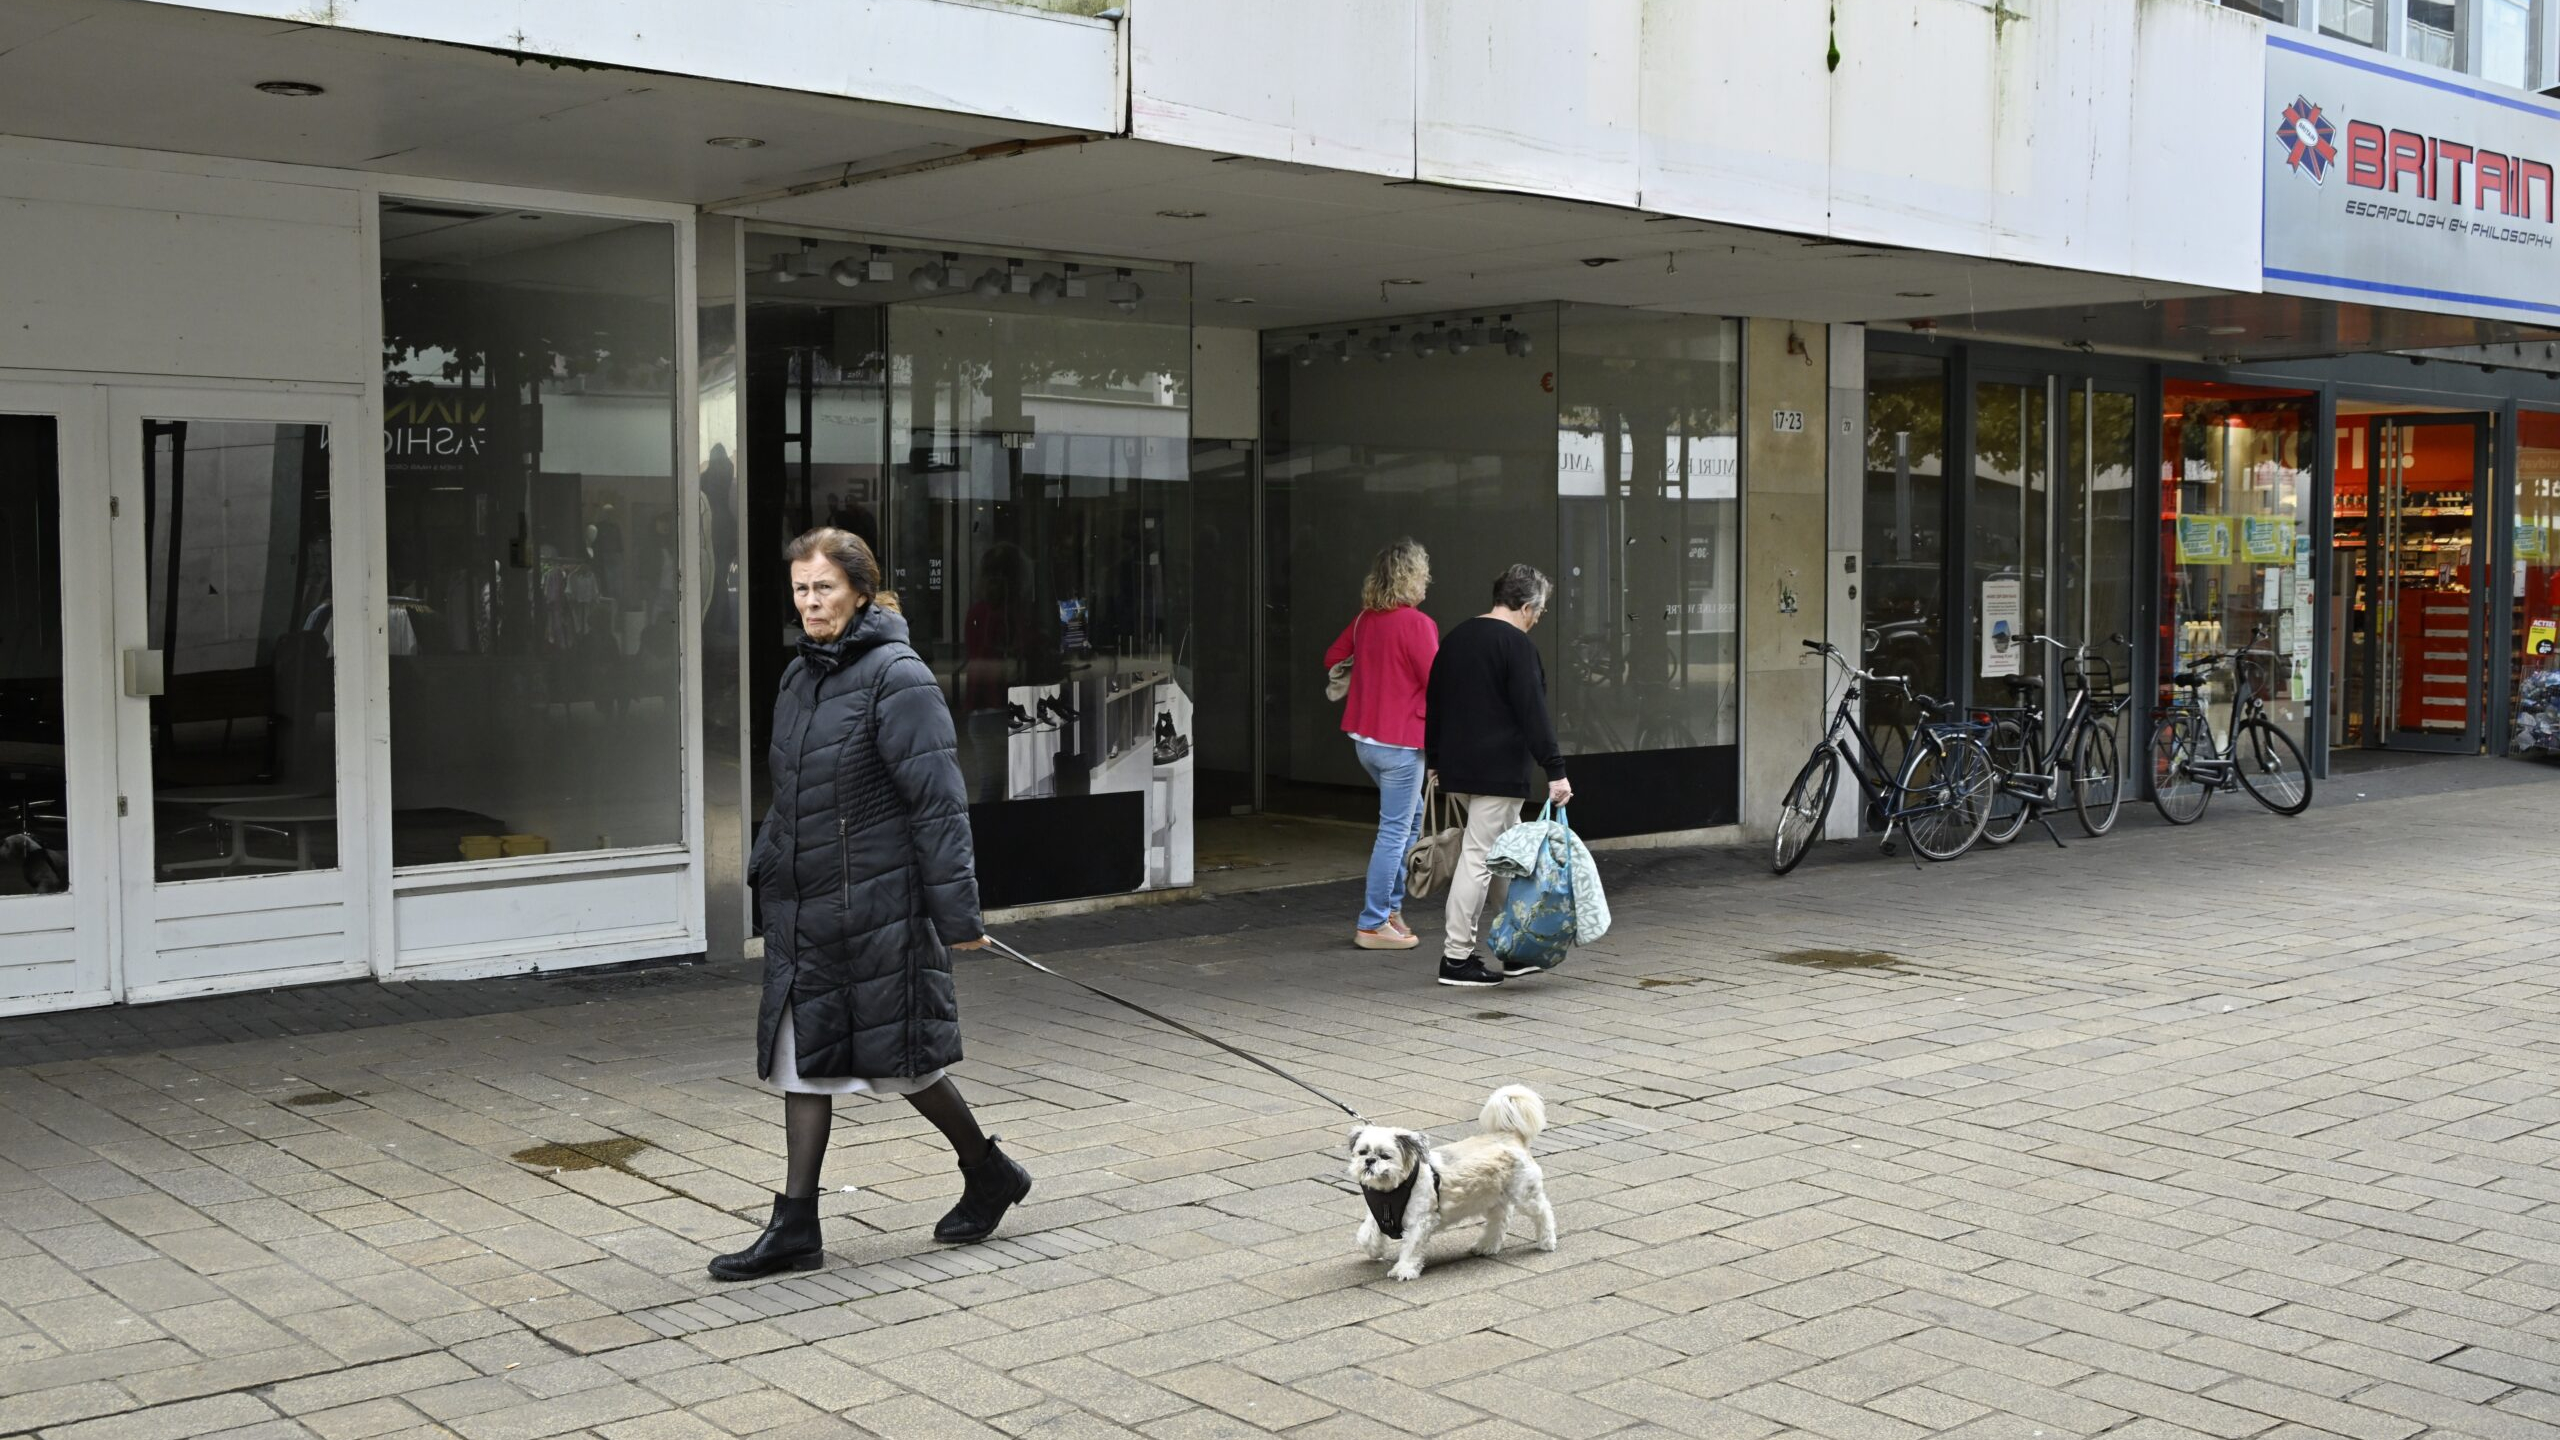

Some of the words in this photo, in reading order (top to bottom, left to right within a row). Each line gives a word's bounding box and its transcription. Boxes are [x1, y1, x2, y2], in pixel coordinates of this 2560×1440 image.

[2298, 122, 2317, 142] BRITAIN
[2346, 119, 2554, 224] BRITAIN
[2346, 200, 2445, 229] ESCAPOLOGY
[2448, 217, 2469, 234] BY
[2470, 222, 2553, 249] PHILOSOPHY
